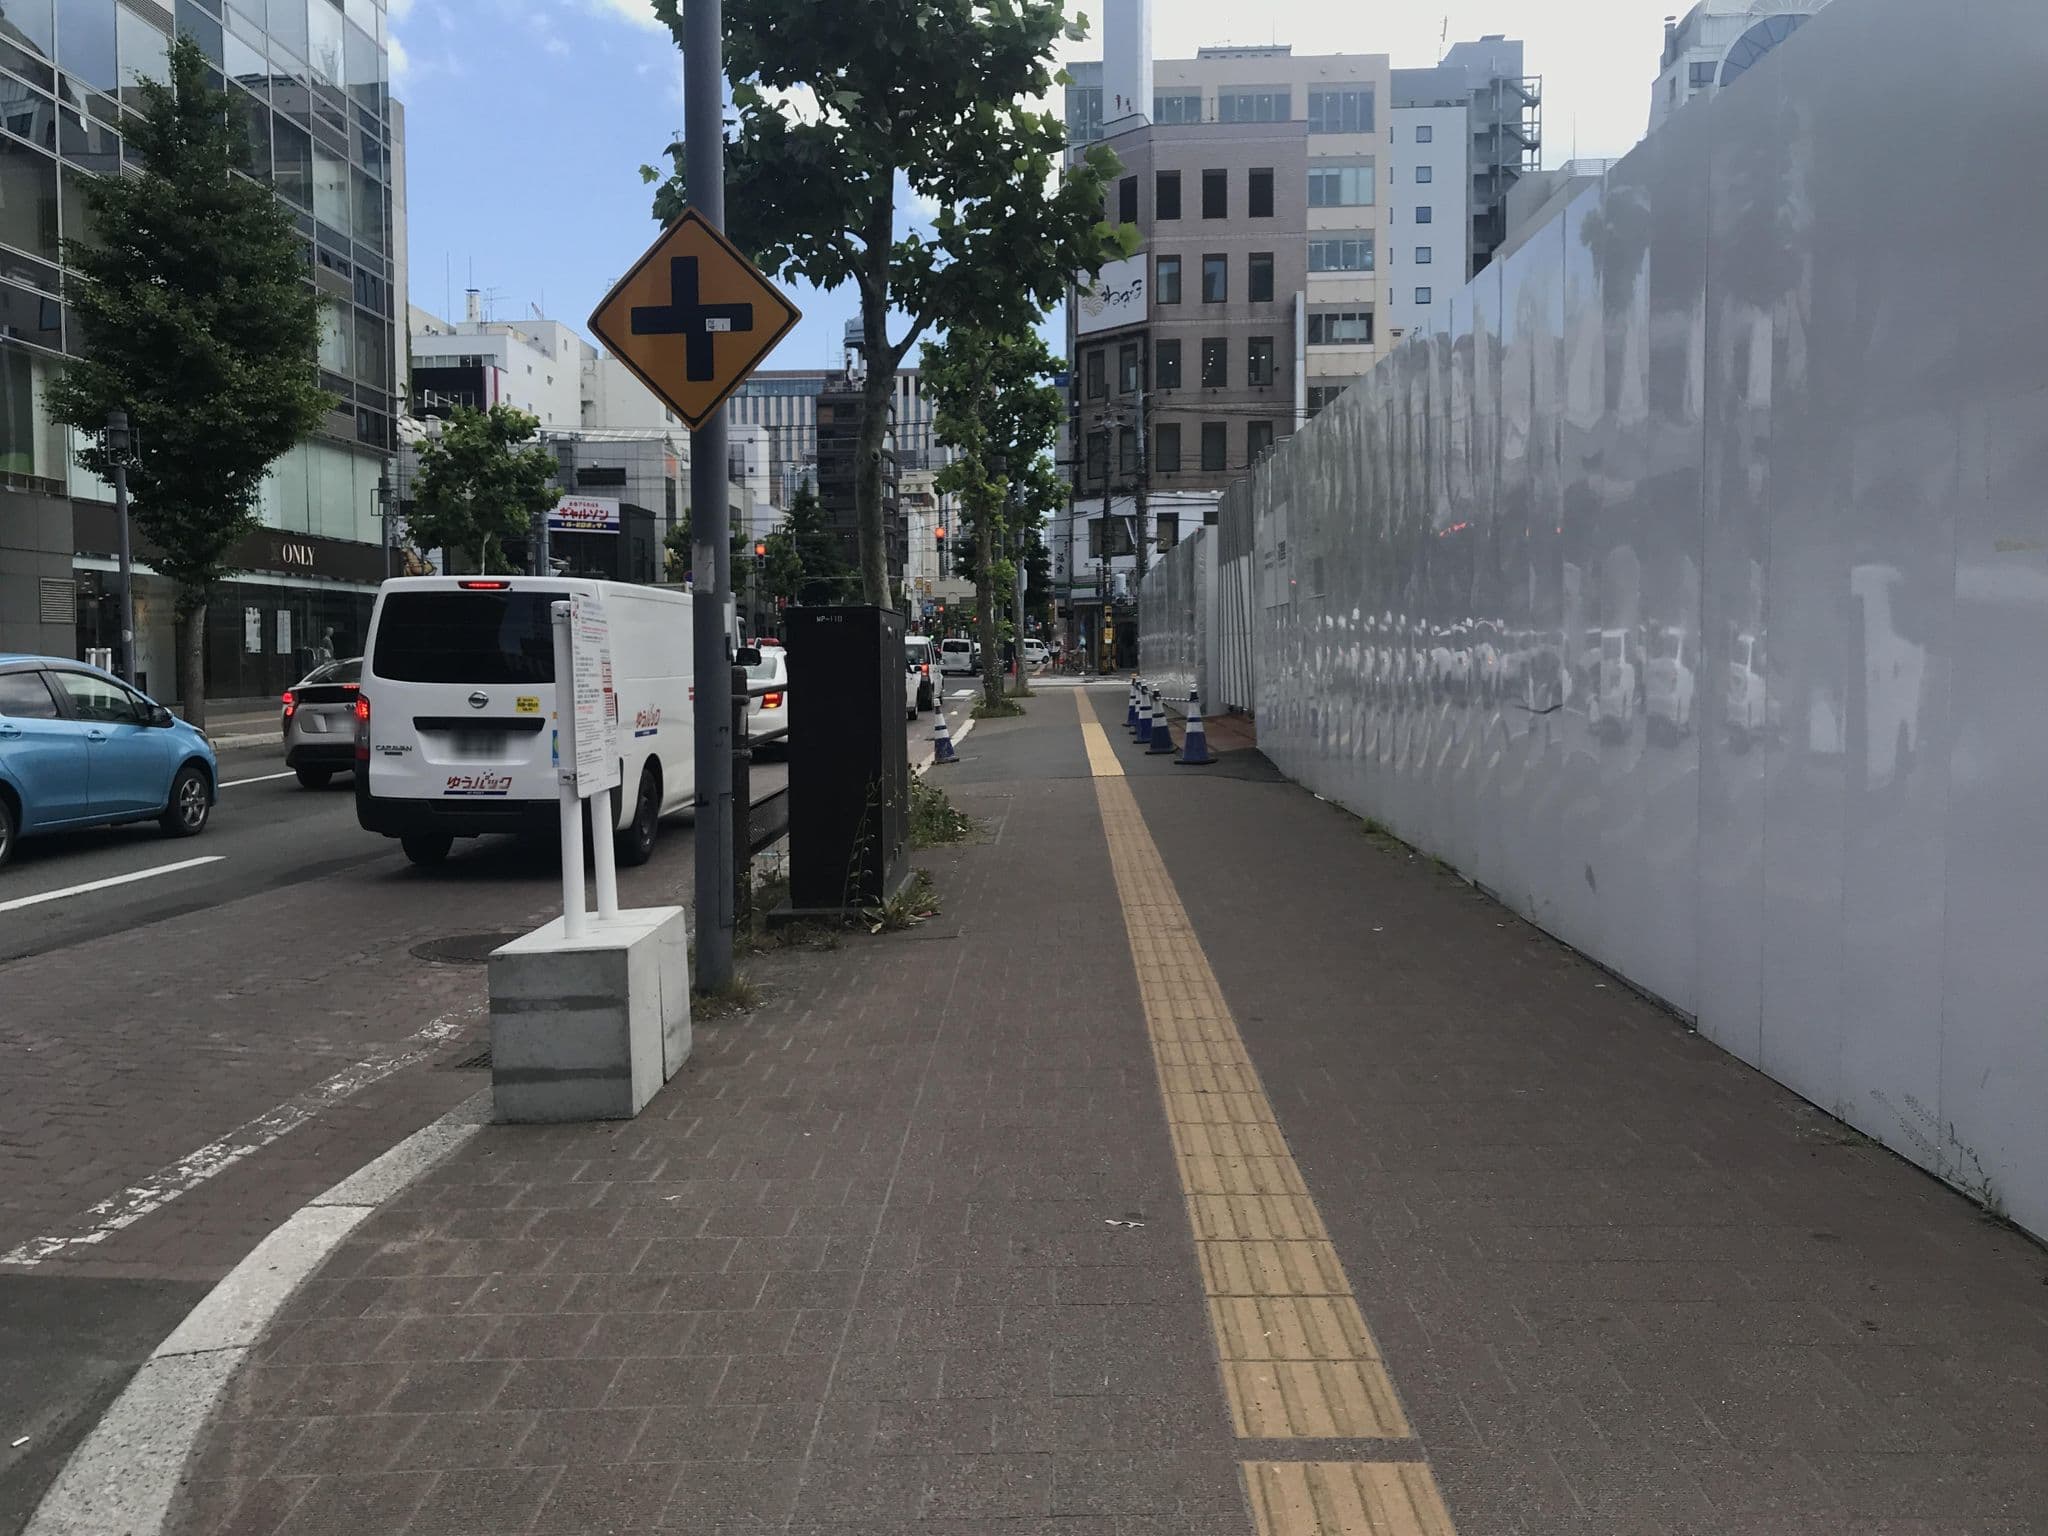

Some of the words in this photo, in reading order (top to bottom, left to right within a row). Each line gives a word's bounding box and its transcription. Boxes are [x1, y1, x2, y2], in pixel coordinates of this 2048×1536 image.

[559, 506, 609, 520] ギャルソン
[282, 544, 316, 566] ONLY
[446, 774, 513, 790] ゆうパック
